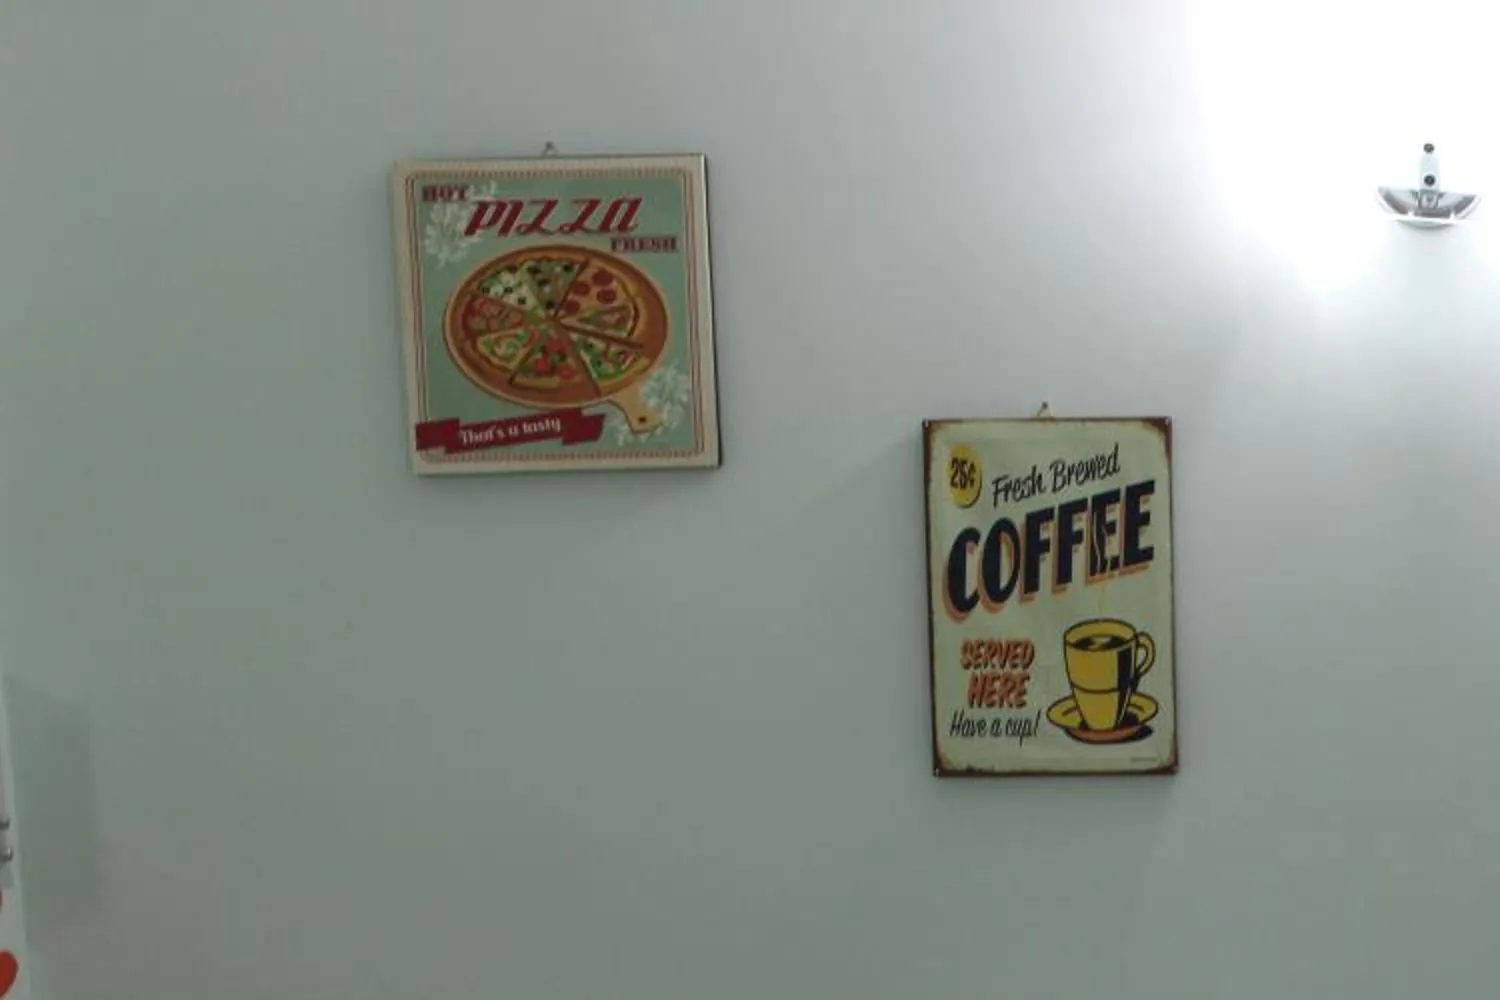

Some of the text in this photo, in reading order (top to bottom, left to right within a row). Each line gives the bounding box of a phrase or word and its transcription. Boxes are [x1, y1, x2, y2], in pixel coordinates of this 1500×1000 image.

[463, 196, 642, 237] PIZZA
[522, 417, 561, 435] tasty
[992, 443, 1120, 508] Fresh Brewed
[945, 479, 1156, 617] COFFEE
[960, 639, 1035, 670] SERVED
[968, 672, 1030, 709] HERE
[949, 708, 1042, 748] Have a cup!
